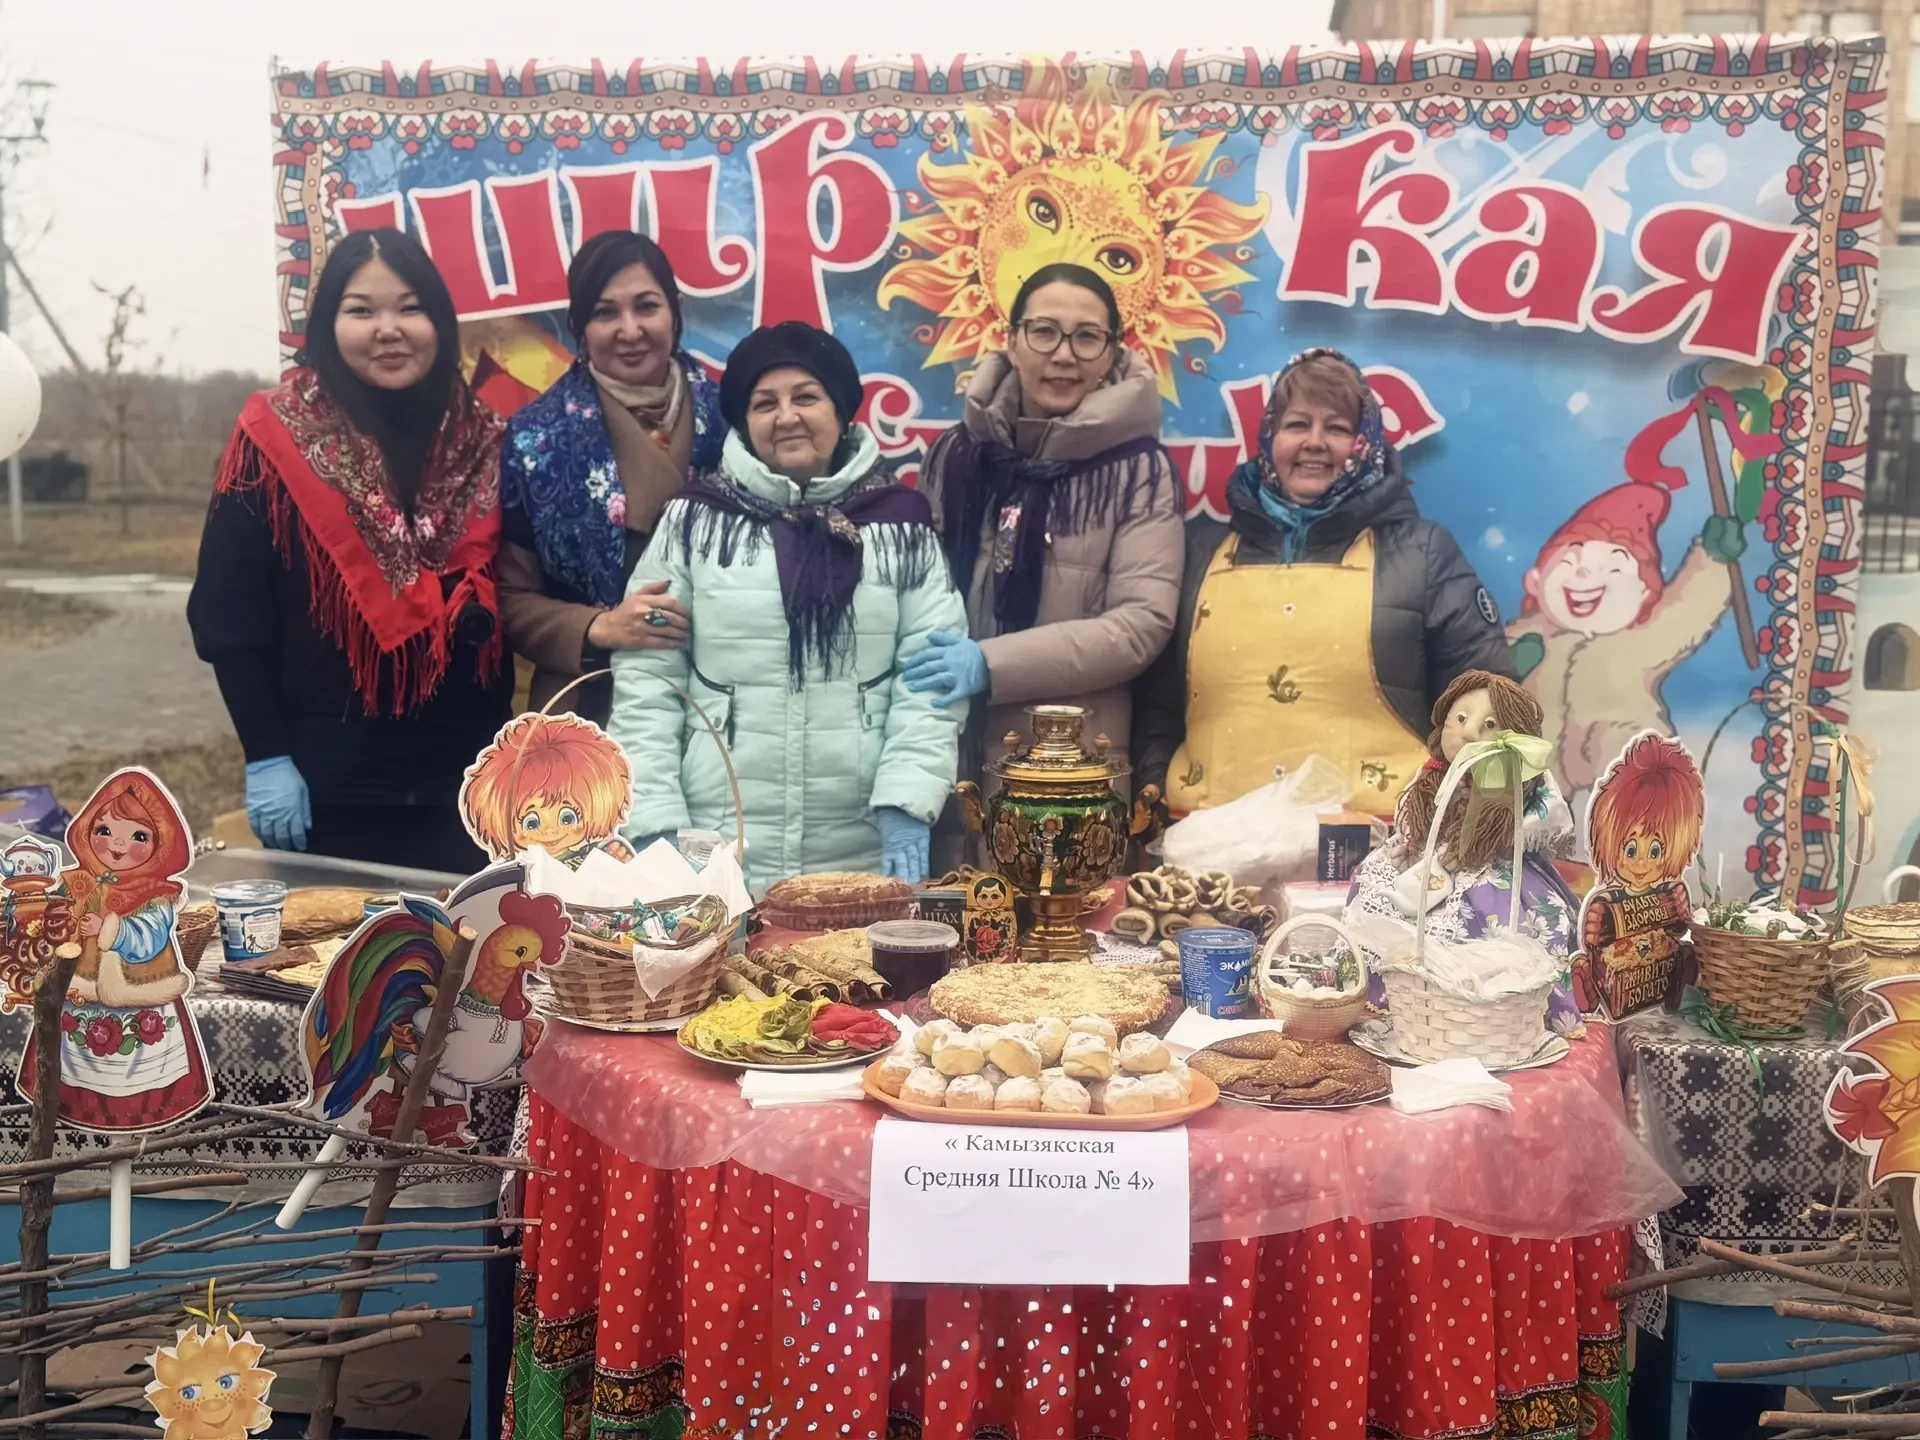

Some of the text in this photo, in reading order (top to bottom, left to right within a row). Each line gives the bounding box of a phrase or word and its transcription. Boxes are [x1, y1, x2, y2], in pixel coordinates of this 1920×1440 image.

[1326, 838, 1335, 878] Herbarus
[1623, 893, 1660, 914] БУДЬТЕ
[925, 912, 959, 923] ШАХ
[1624, 907, 1668, 930] ЗДОРОВЫ
[1624, 957, 1674, 990] ЖИВИТЕ
[1628, 976, 1669, 1008] БОГАТО
[965, 1134, 1115, 1153] Камызякская
[904, 1165, 1154, 1191] Средняя Школа № 4»
